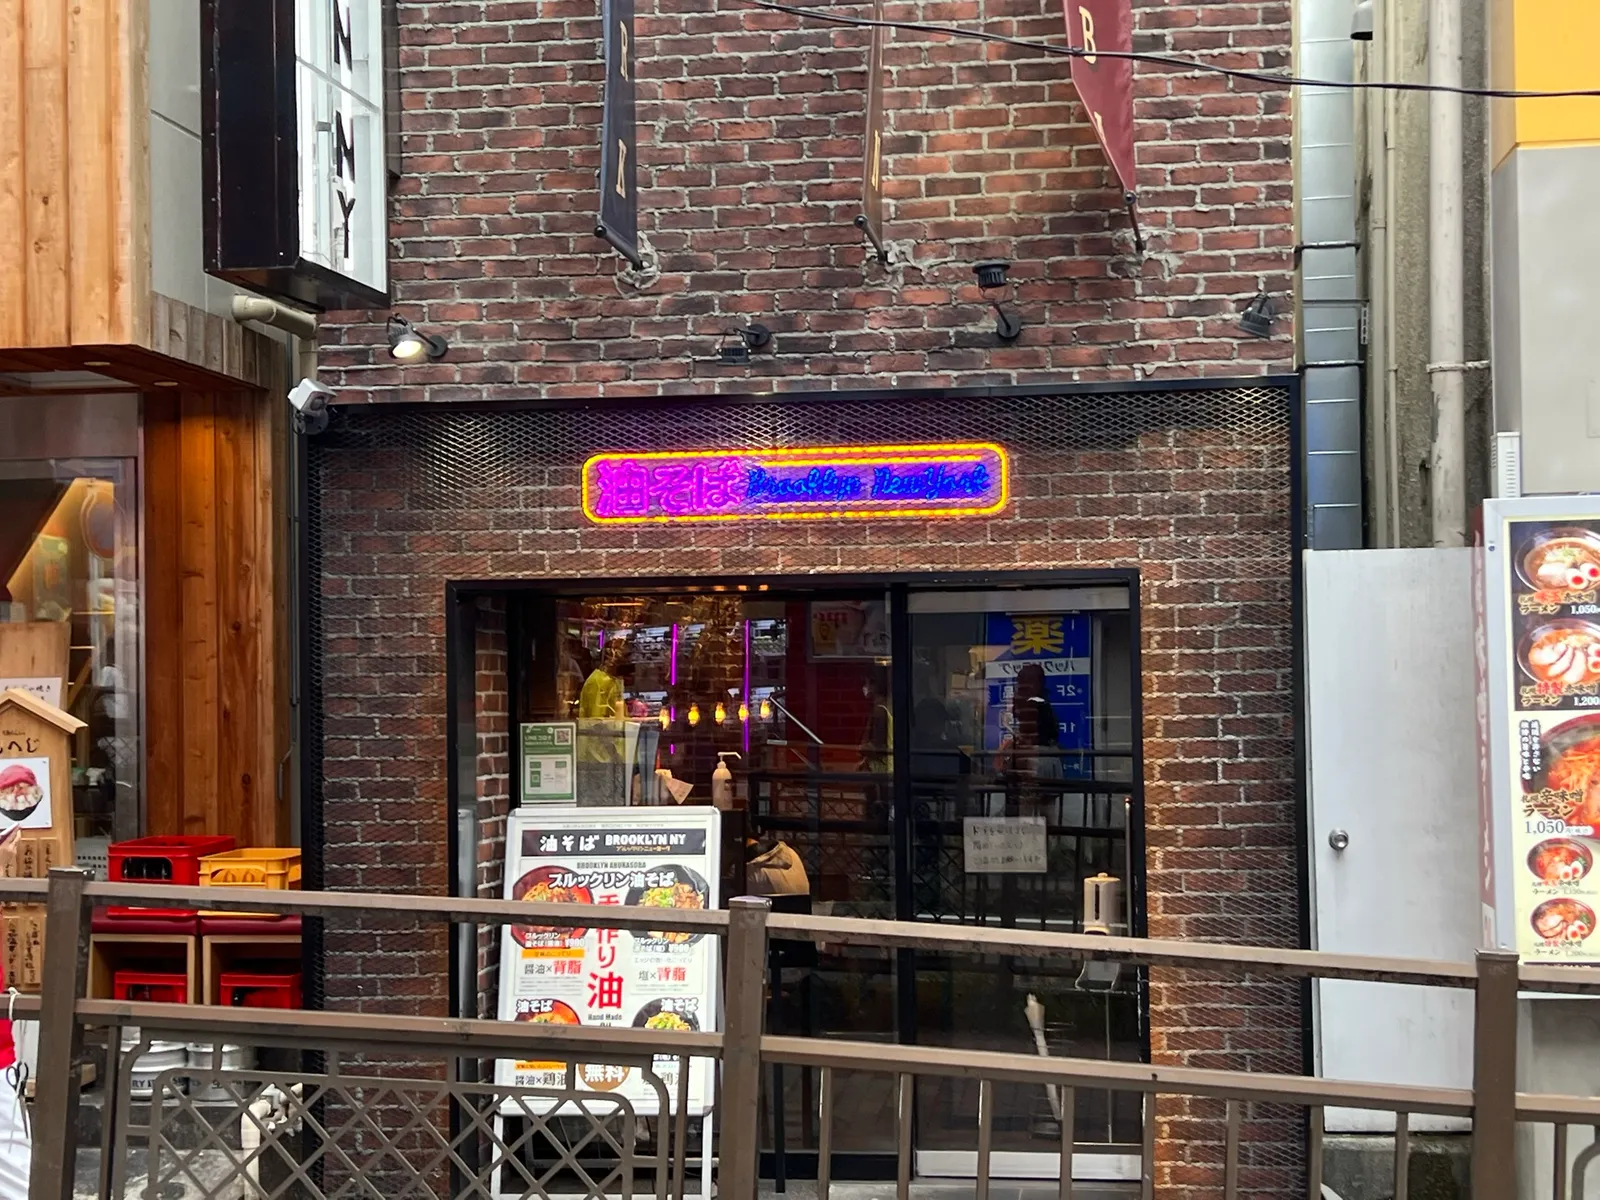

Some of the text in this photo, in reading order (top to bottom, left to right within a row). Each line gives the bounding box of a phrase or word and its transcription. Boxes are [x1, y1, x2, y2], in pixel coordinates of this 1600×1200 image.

[595, 456, 744, 517] 油そば
[1519, 604, 1560, 615] ラーメン
[1521, 697, 1562, 707] ラーメン
[1523, 804, 1574, 817] ラーメン
[540, 834, 686, 852] 油そば BROOKLYN NY
[516, 998, 553, 1013] 油そば
[661, 998, 699, 1012] 油そば
[584, 1064, 625, 1083] 無料
